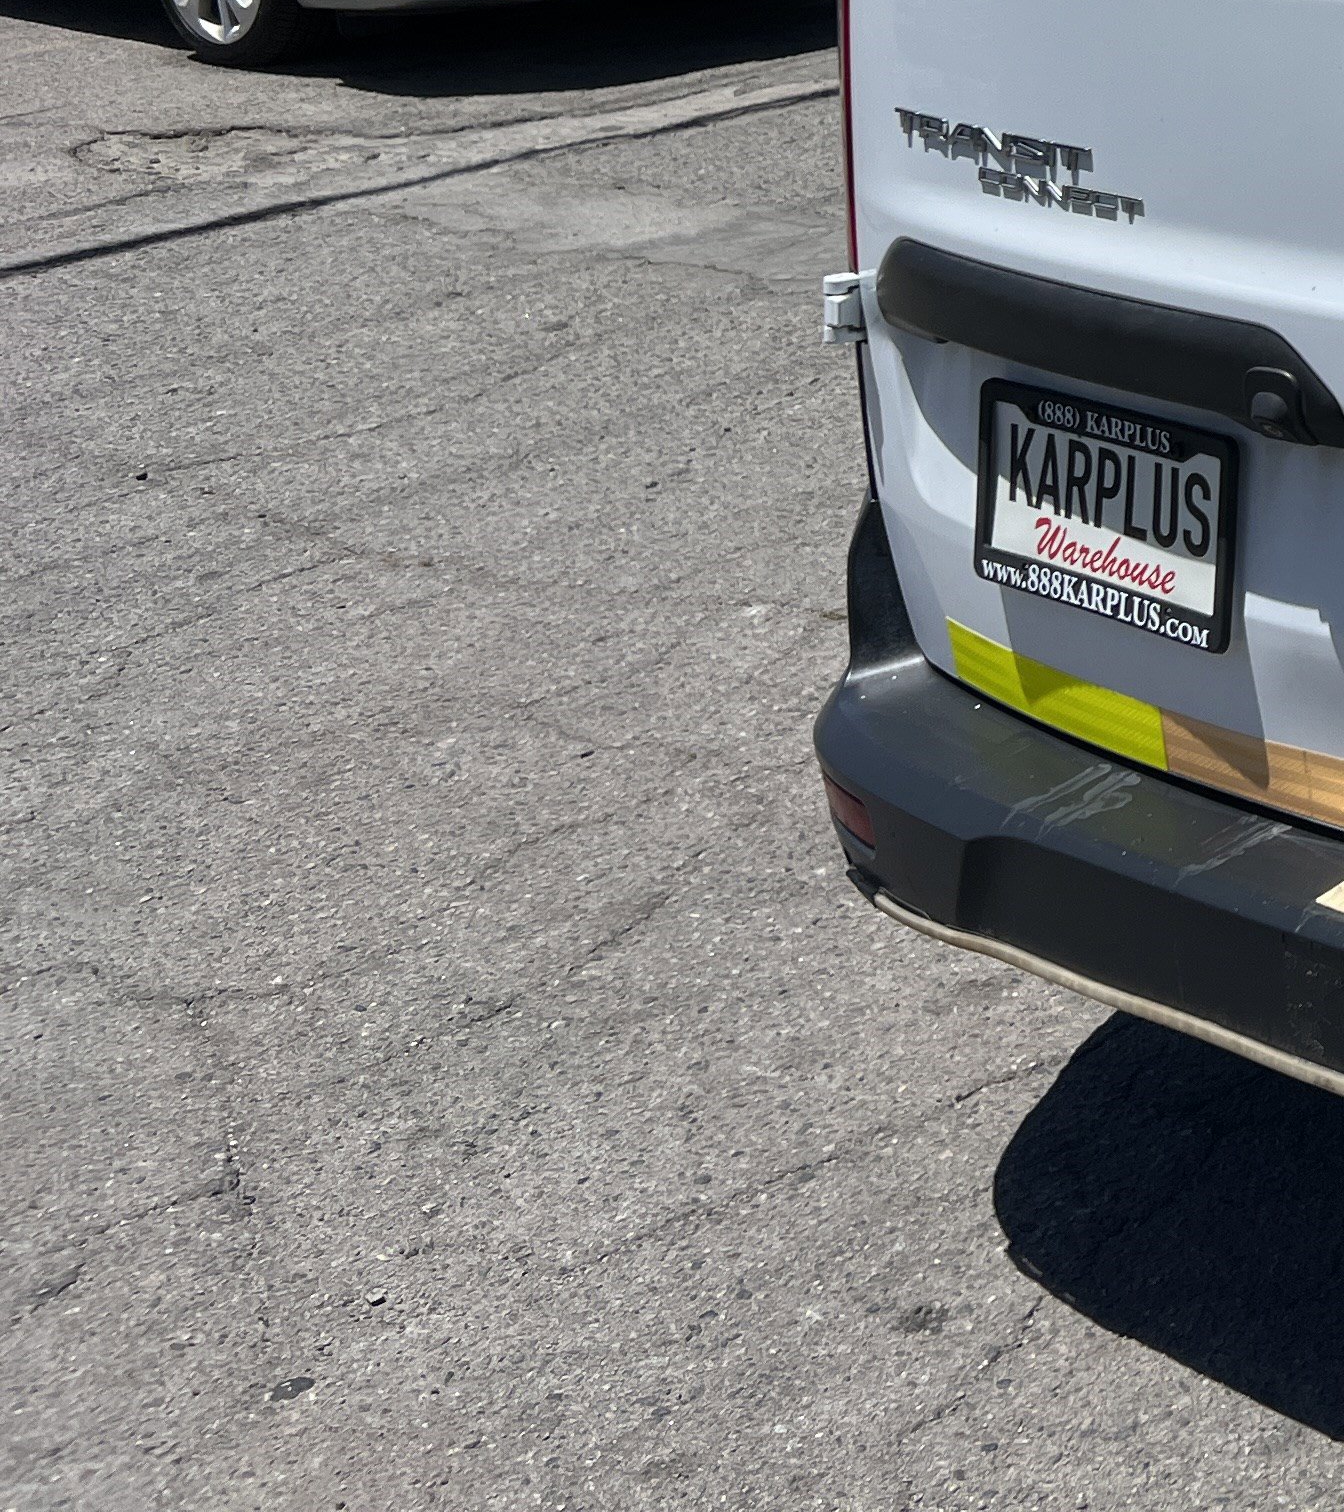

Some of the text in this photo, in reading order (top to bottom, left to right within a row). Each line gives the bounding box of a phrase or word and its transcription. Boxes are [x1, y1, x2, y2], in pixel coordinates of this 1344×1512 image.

[894, 107, 1093, 171] TRANSIT
[979, 167, 1144, 215] CONNECT
[1038, 400, 1171, 454] (888) KARPLUS
[1009, 423, 1212, 558] KARPLUS
[1034, 517, 1176, 595] Warehouse
